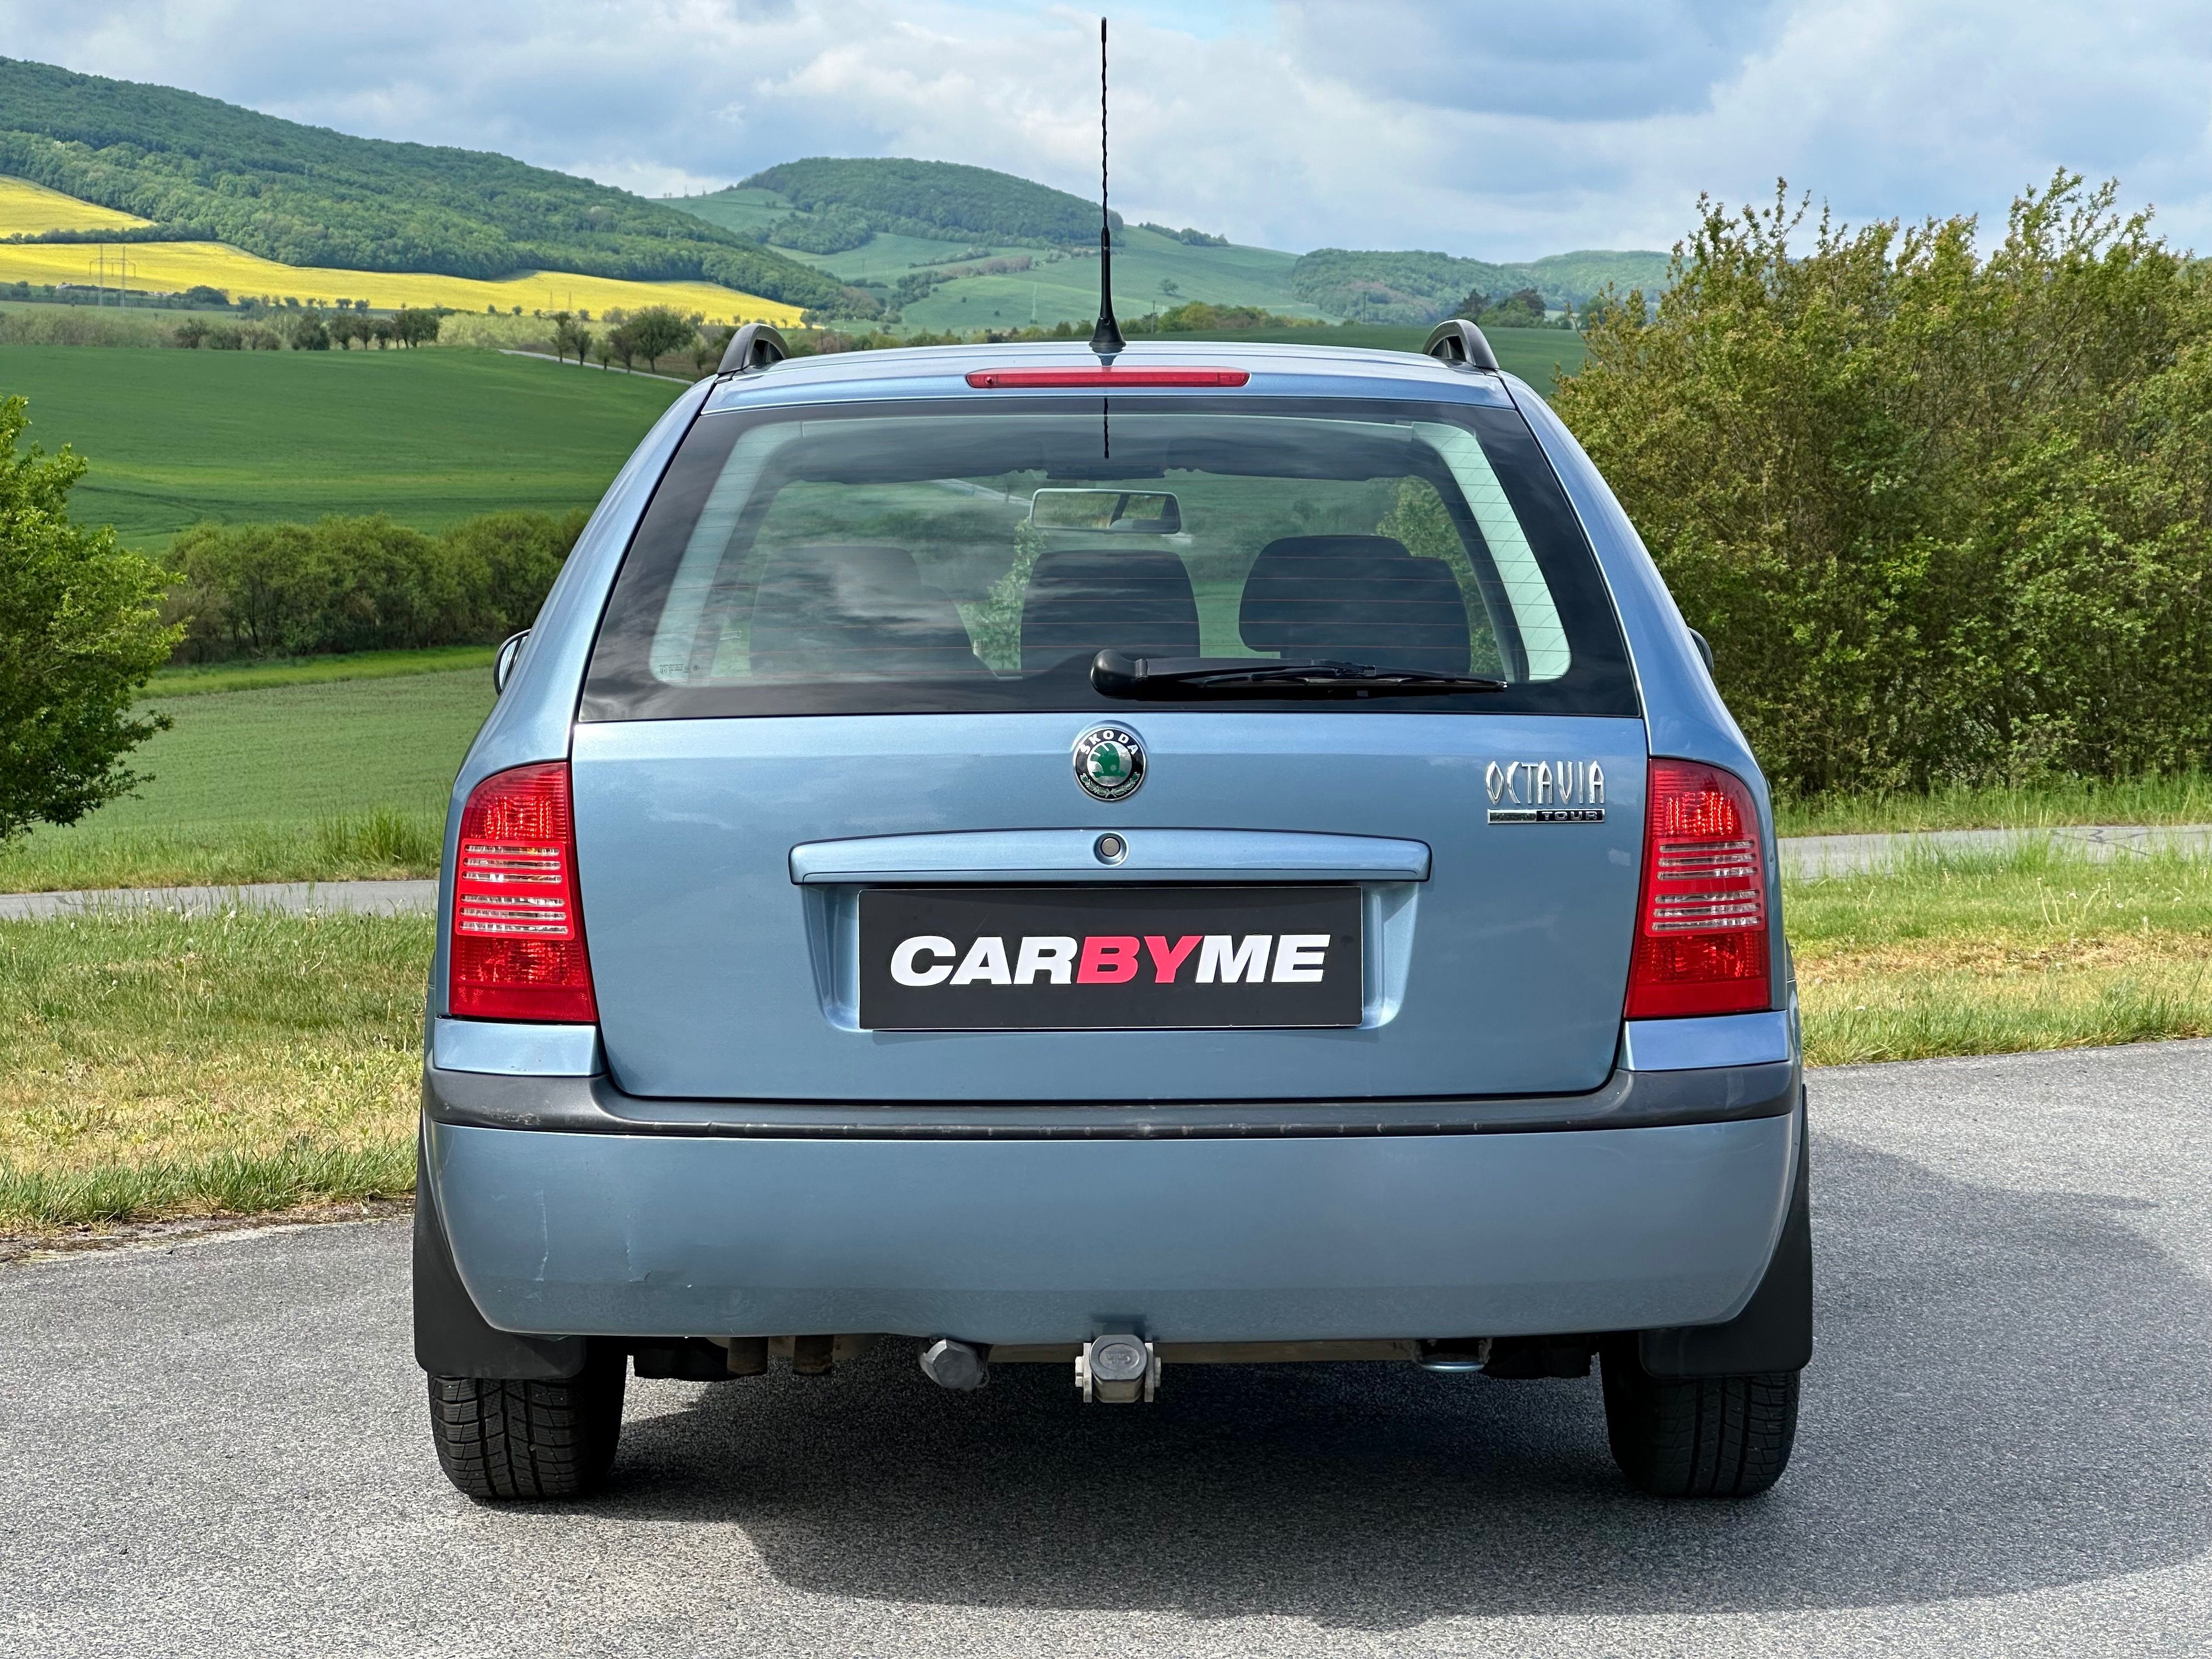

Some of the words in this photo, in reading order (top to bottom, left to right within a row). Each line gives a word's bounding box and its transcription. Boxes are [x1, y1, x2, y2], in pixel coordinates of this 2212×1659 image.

[1486, 760, 1605, 805] OCTAVIA
[1542, 811, 1597, 821] TOUR
[890, 934, 1331, 986] CARBYME
